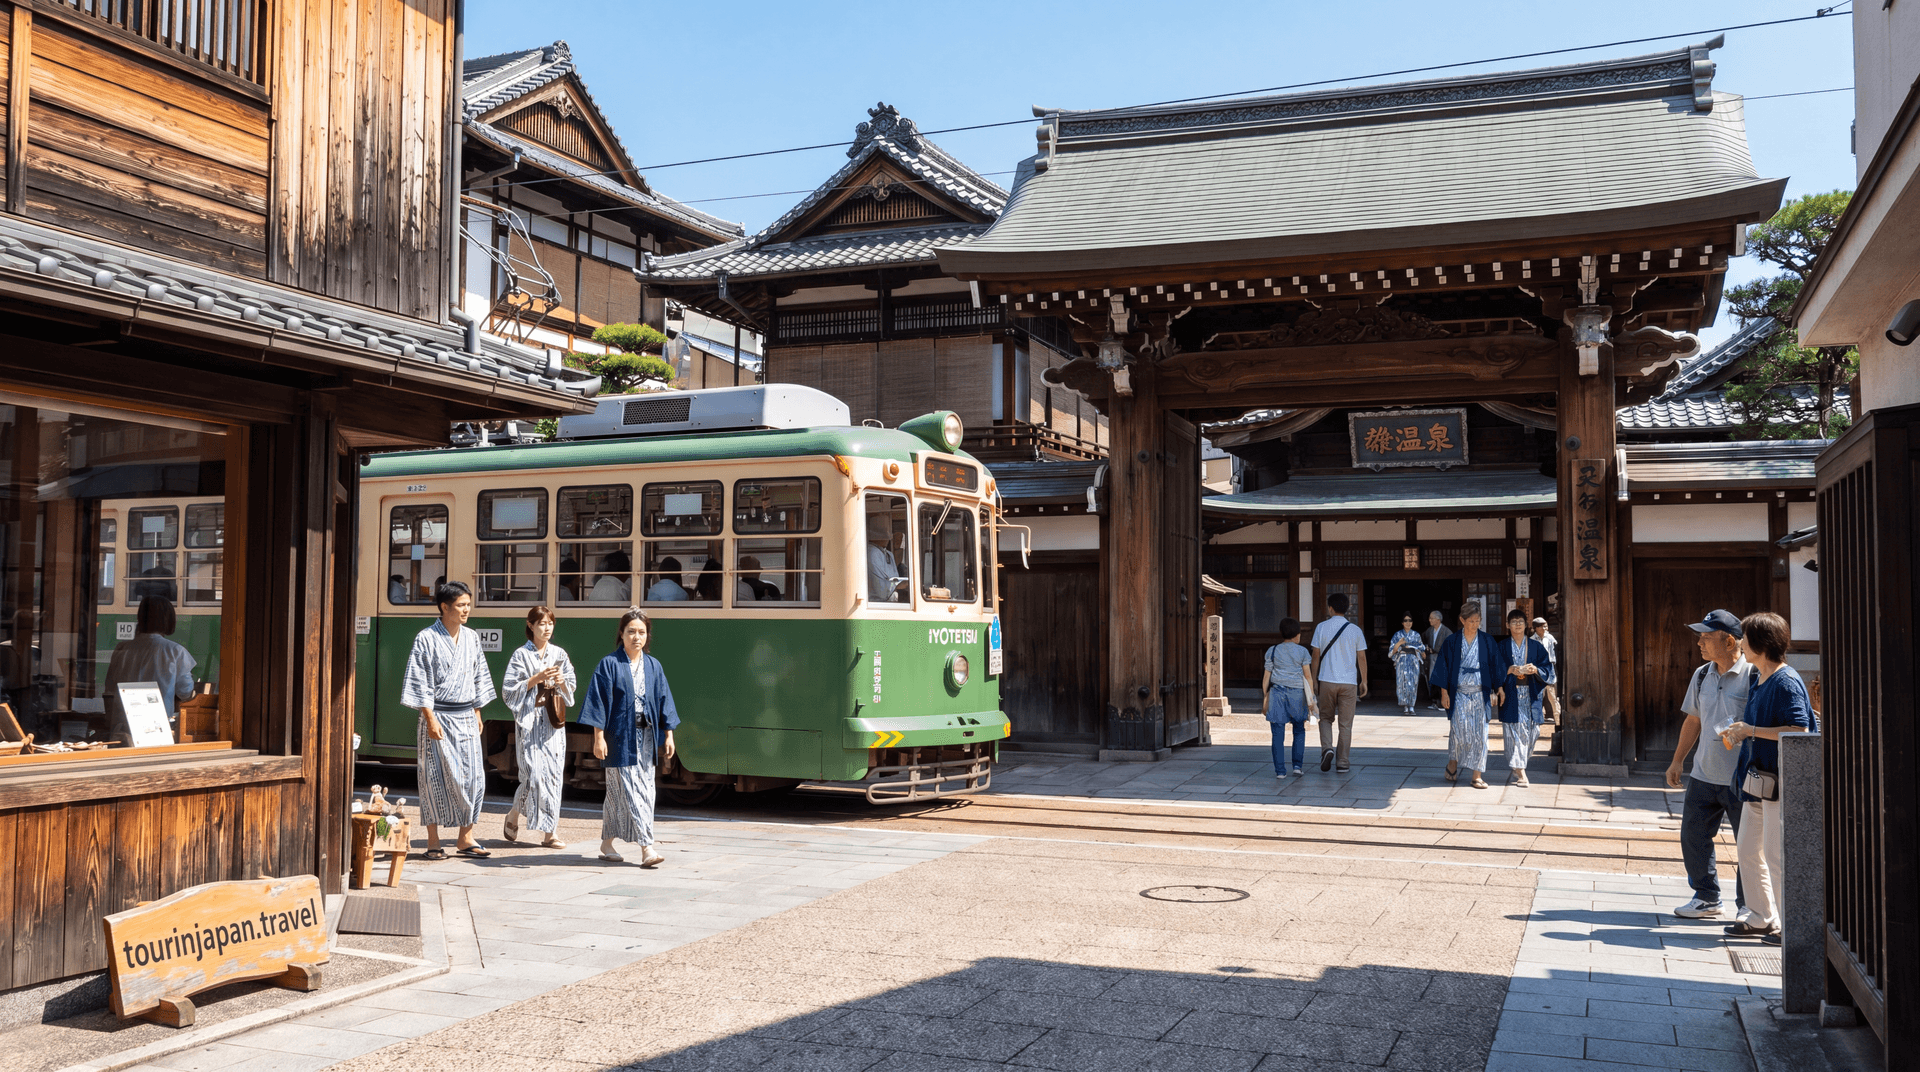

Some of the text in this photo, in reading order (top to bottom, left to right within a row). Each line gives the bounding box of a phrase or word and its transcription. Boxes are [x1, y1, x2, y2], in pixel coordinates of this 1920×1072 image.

[480, 632, 499, 642] HD
[928, 627, 978, 645] IYOTETSU
[123, 898, 318, 969] tourinjapan.travel
